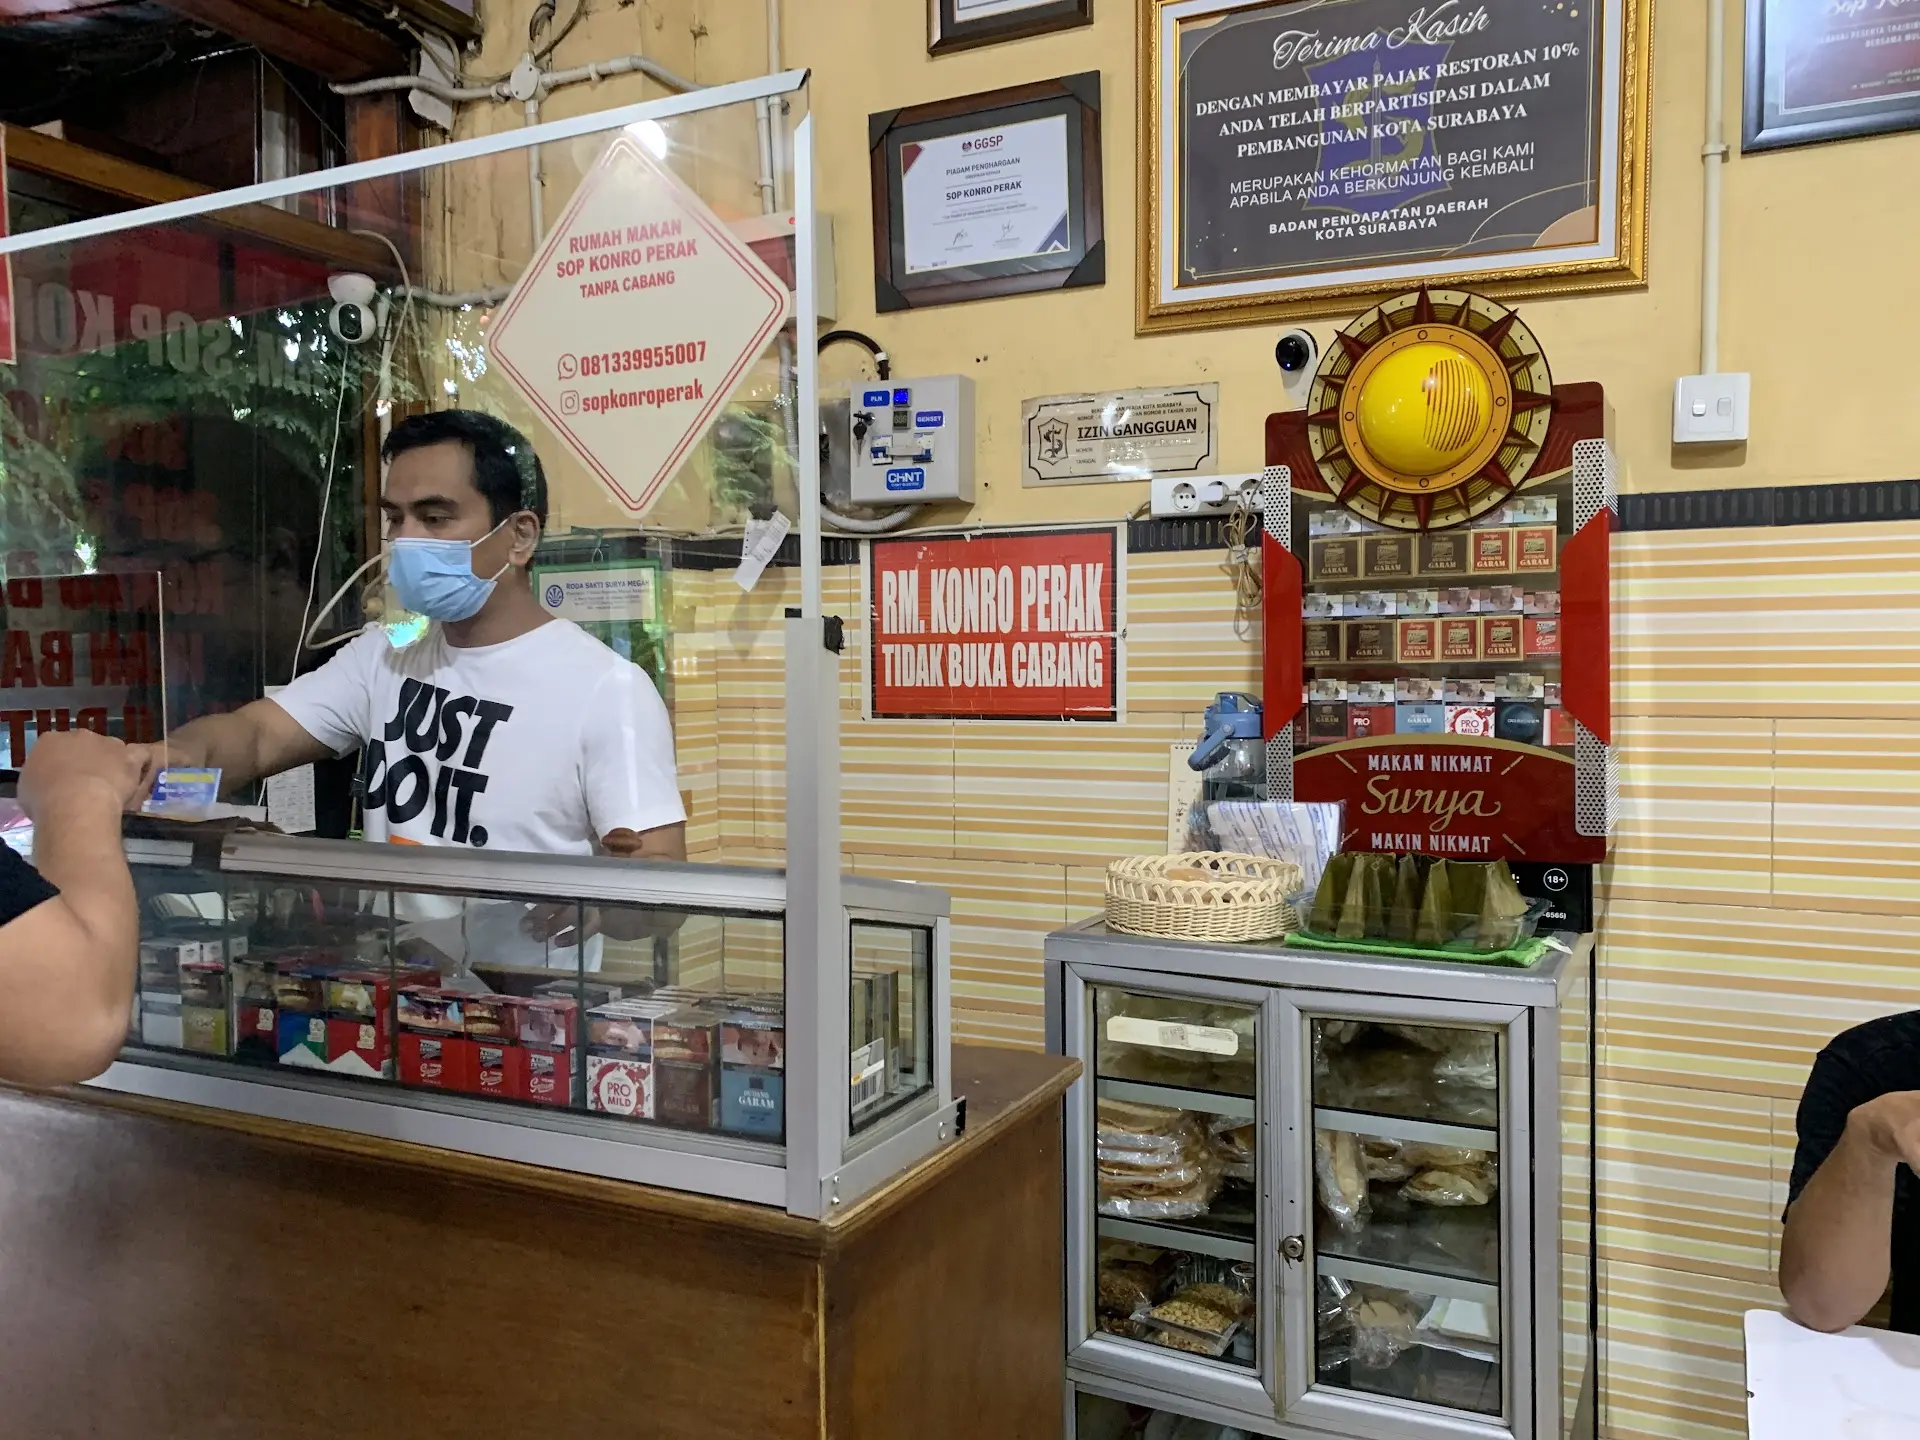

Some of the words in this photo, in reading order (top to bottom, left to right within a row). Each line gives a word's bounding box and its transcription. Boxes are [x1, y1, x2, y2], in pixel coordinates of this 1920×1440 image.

[1273, 29, 1383, 71] Terima
[1387, 0, 1490, 49] Kasih
[1196, 92, 1264, 117] DENGAN
[1268, 76, 1369, 105] MEMBAYAR
[1373, 65, 1431, 88] PAJAK
[1436, 48, 1537, 78] RESTORAN
[1542, 42, 1580, 61] 10%
[1218, 118, 1265, 137] ANDA
[1269, 109, 1325, 129] TELAH
[1330, 84, 1476, 120] BERPARTISIPASI
[1481, 72, 1551, 97] DALAM
[974, 135, 1003, 150] GGSP
[1237, 128, 1368, 157] PEMBANGUNAN
[1372, 119, 1422, 139] KOTA
[1427, 103, 1528, 131] SURABAYA
[946, 165, 971, 176] PIAGAM
[971, 156, 1021, 172] PENGHARGAAN
[1229, 191, 1293, 209] APABILA
[1297, 184, 1340, 201] ANDA
[1344, 169, 1455, 195] BERKUNJUNG
[1460, 158, 1534, 179] KEMBALI
[1230, 170, 1325, 194] MERUPAKAN
[1330, 154, 1442, 182] KEHORMATAN
[1448, 148, 1487, 166] BAGI
[1493, 141, 1535, 159] KAMI
[946, 190, 962, 200] SOP
[963, 186, 993, 198] KONRO
[993, 180, 1022, 193] PERAK
[1269, 218, 1318, 234] BADAN
[1322, 206, 1421, 228] PENDAPATAN
[1426, 198, 1489, 216] DAERAH
[1315, 226, 1354, 240] KOTA
[1358, 216, 1438, 236] SURABAYA
[569, 228, 622, 254] RUMAH
[626, 219, 682, 244] MAKAN
[556, 257, 585, 278] SOP
[589, 248, 642, 272] KONRO
[646, 238, 698, 263] PERAK
[580, 279, 620, 298] TANPA
[622, 270, 675, 292] CABANG
[580, 340, 706, 377] 081339955007
[582, 378, 704, 415] sopkonroperak
[1077, 425, 1109, 439] IZIN
[1112, 418, 1197, 437] GANGGUAN
[881, 569, 925, 635] RM.
[930, 565, 1014, 635] KONRO
[1020, 563, 1104, 633] PERAK
[882, 643, 944, 687] TIDAK
[948, 642, 1008, 688] BUKA
[1011, 641, 1103, 688] CABANG
[384, 677, 515, 769] JUST
[1353, 717, 1370, 726] PRO
[1460, 719, 1480, 728] PRO
[1367, 754, 1425, 772] MAKAN
[1431, 754, 1493, 773] NIKMAT
[362, 738, 430, 824] DO
[430, 765, 489, 848] IT.
[1360, 774, 1502, 833] Surya
[1371, 832, 1422, 851] MAKIN
[1429, 833, 1491, 853] NIKMAT
[1546, 875, 1565, 884] 18+
[607, 1081, 631, 1097] PRO
[607, 1096, 632, 1108] MILD
[738, 1096, 775, 1109] GARAM
